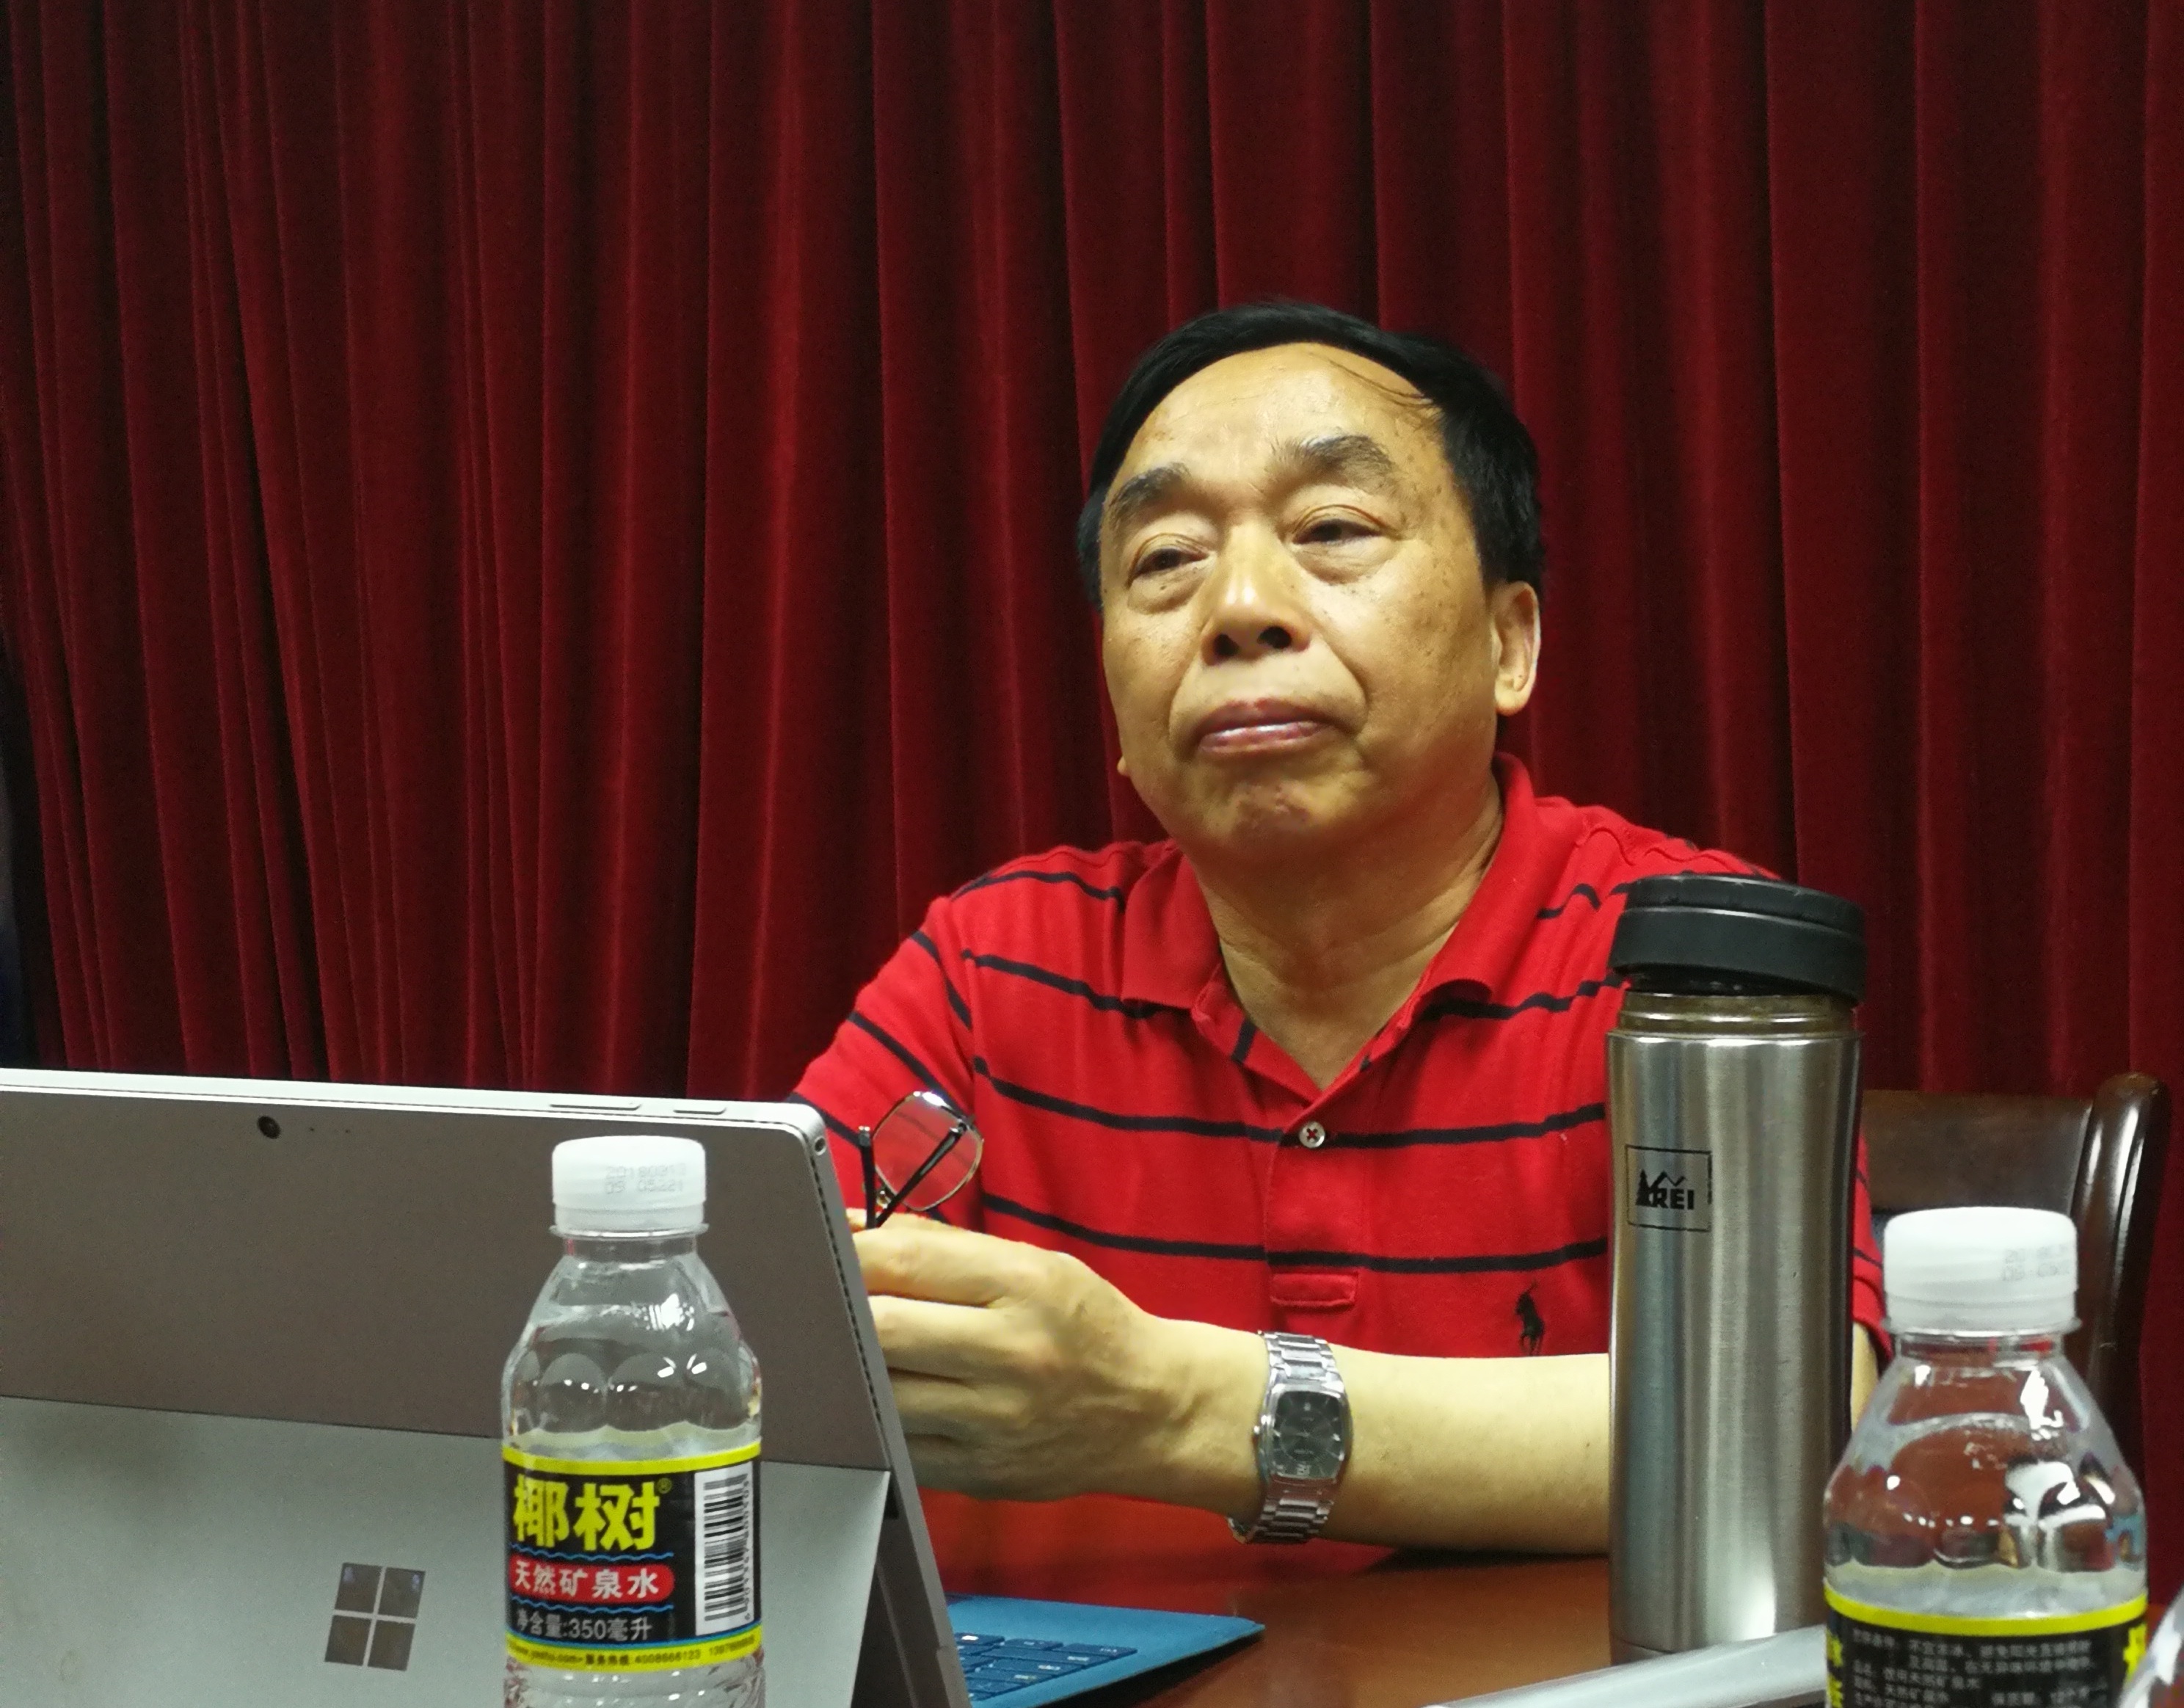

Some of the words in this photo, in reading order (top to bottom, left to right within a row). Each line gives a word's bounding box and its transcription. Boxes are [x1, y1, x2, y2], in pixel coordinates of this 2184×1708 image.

[1653, 1188, 1695, 1210] REI
[514, 1473, 660, 1551] 椰树
[514, 1559, 659, 1599] 天然矿泉水
